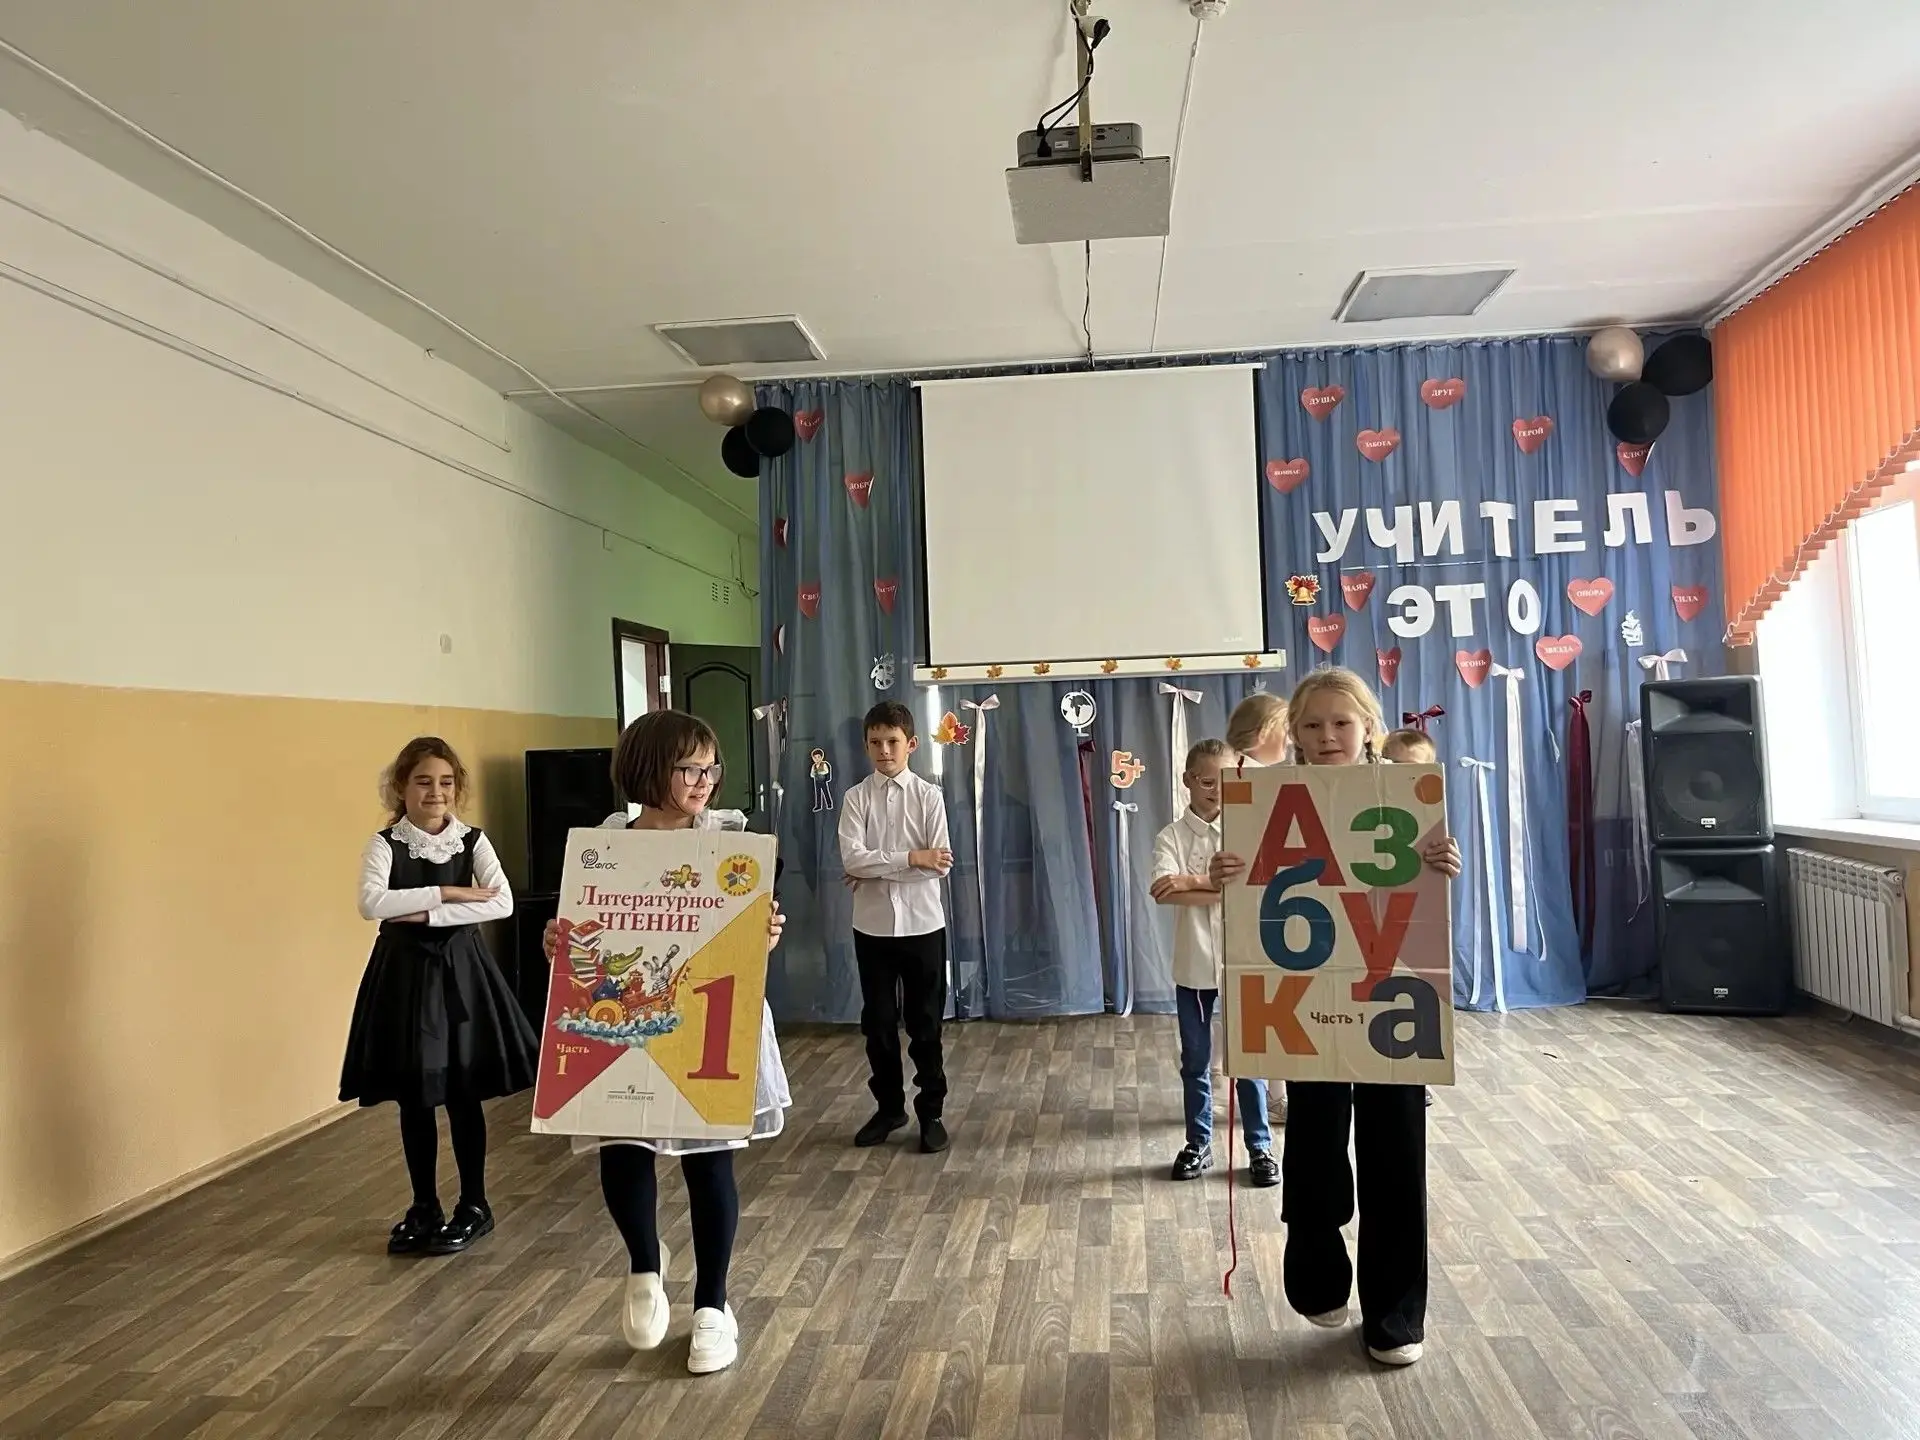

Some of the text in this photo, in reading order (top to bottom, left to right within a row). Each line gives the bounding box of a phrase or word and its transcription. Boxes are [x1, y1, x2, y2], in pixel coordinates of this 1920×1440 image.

[1431, 387, 1455, 397] ДРУГ
[1308, 395, 1336, 406] ДУША
[1518, 426, 1544, 437] ГЕРОЙ
[1364, 440, 1392, 448] ЗАБОТА
[1312, 490, 1716, 564] УЧИТЕЛЬ
[1342, 582, 1369, 592] МАЯК
[1576, 589, 1605, 597] ОПОРА
[1673, 594, 1699, 602] СИЛА
[1387, 578, 1541, 638] ЭТО
[1311, 623, 1339, 634] ТЕПЛО
[594, 862, 619, 870] ФГОС
[577, 885, 725, 912] Литературное
[599, 911, 700, 933] ЧТЕНИЕ
[1310, 1011, 1365, 1025] Часть 1
[687, 975, 740, 1080] 1
[556, 1043, 590, 1054] Часть
[556, 1053, 568, 1075] 1
